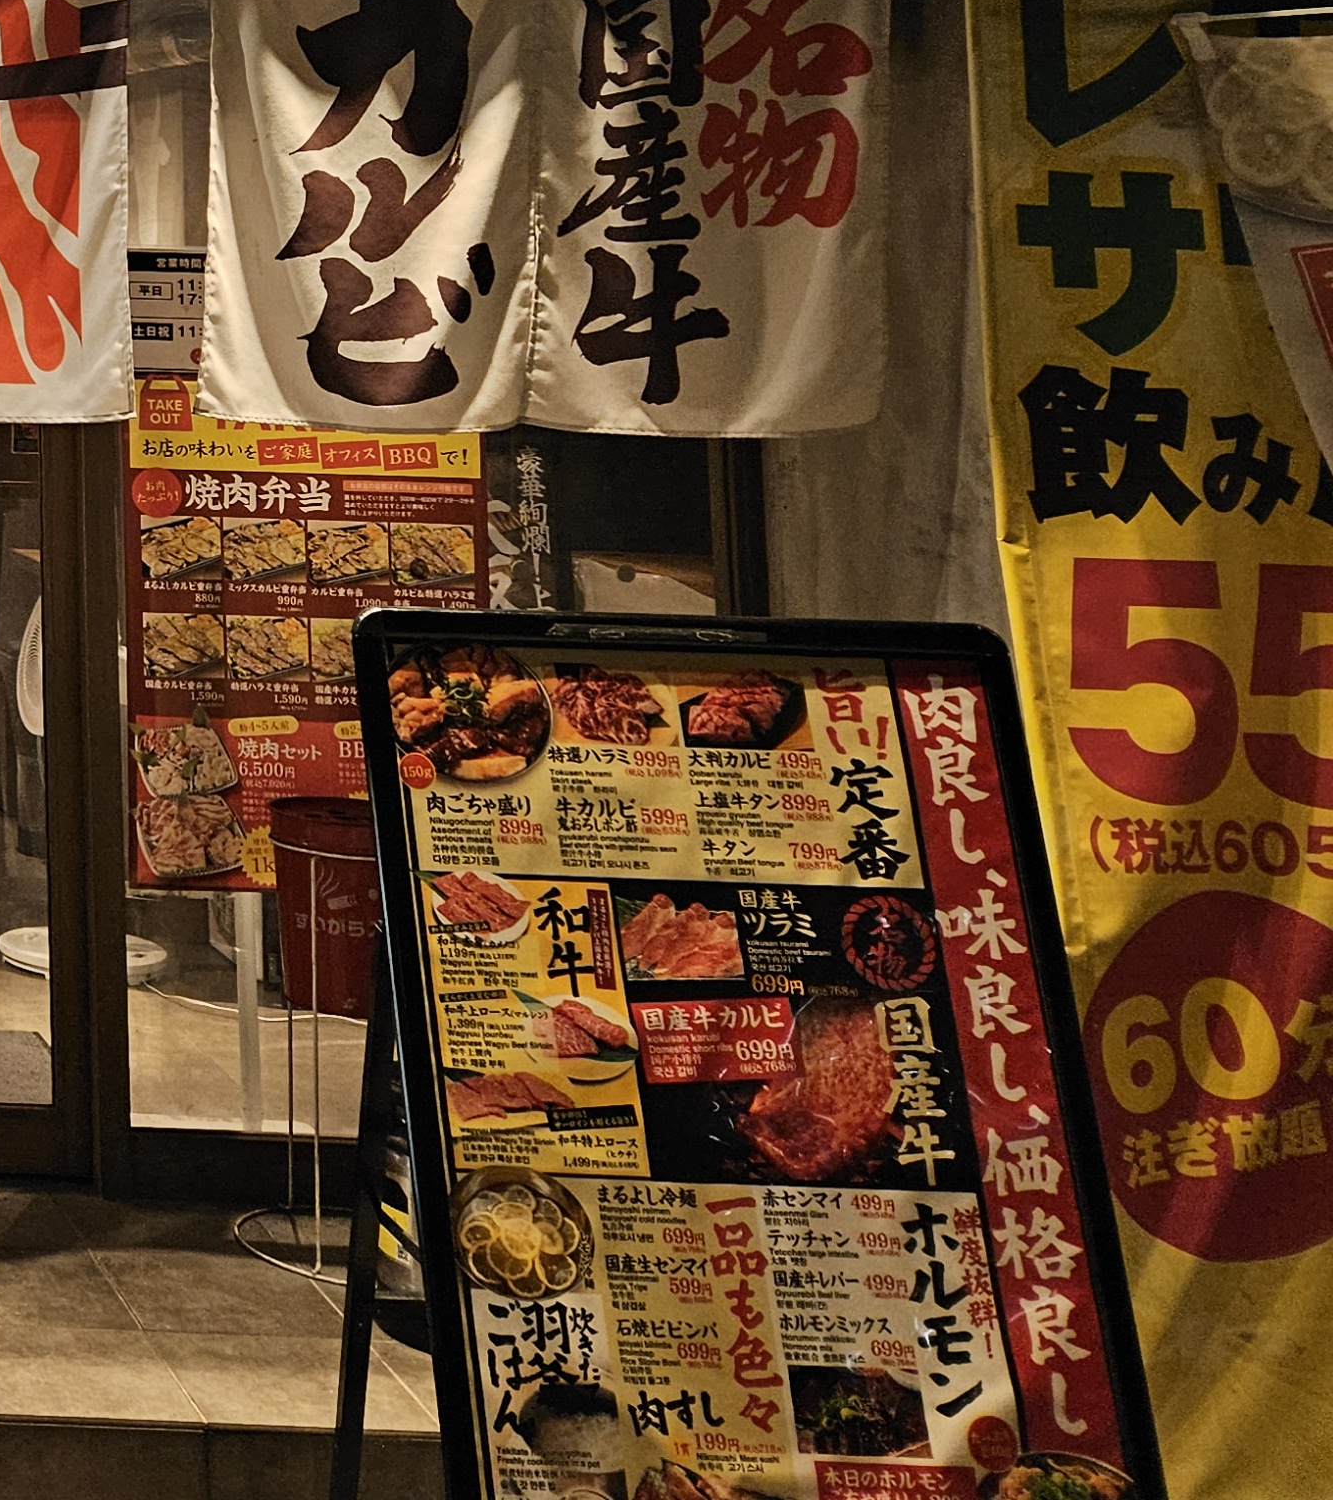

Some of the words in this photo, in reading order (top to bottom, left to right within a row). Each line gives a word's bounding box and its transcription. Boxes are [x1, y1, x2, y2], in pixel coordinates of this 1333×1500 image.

[139, 285, 162, 296] 平日
[134, 326, 170, 337] 土日祝
[147, 399, 183, 411] TAKE
[150, 413, 180, 424] OUT
[142, 438, 257, 459] お店の味わいを
[263, 441, 313, 459] ご家庭
[324, 447, 376, 462] オフィス
[389, 447, 431, 465] BBQ
[185, 474, 331, 514] 焼肉弁当
[195, 593, 220, 604] 880円
[277, 595, 304, 607] 990円
[238, 738, 321, 761] 焼肉セット
[548, 746, 630, 764] 特選ハラミ
[634, 751, 680, 769] 999円
[689, 750, 771, 769] 大判カルビ
[777, 753, 822, 771] 499円
[239, 762, 295, 779] 6,500円
[401, 764, 432, 781] 150g
[426, 791, 531, 816] 肉ごちゃ盛り
[556, 796, 636, 818] 牛カルビ
[695, 791, 780, 810] 上塩牛タン
[782, 794, 830, 813] 899円
[641, 808, 688, 827] 599円
[829, 758, 910, 881] 定番
[499, 819, 543, 836] 899円
[702, 838, 755, 857] 牛タン
[788, 843, 839, 861] 799円
[738, 888, 801, 910] 国産牛
[743, 912, 817, 938] ツラミ
[534, 887, 594, 997] 和牛
[752, 973, 804, 995] 699円
[641, 1003, 785, 1032] 国産牛カルビ
[736, 1039, 794, 1061] 699円
[874, 997, 955, 1185] 国産牛
[558, 1135, 638, 1148] 和牛特上ロース
[597, 1185, 697, 1208] まるよし冷麺
[763, 1189, 842, 1209] 赤センマイ
[851, 1195, 895, 1213] 499円
[663, 1228, 705, 1246] 699円
[768, 1229, 850, 1248] テッチャン
[857, 1232, 901, 1251] 499円
[670, 1278, 712, 1297] 599円
[773, 1270, 859, 1288] 国産牛レバー
[864, 1274, 908, 1293] 499円
[705, 1196, 783, 1434] 一品も色々
[901, 1203, 983, 1418] ホルモン
[617, 1319, 719, 1340] 石焼ビビンバ
[779, 1313, 892, 1334] ホルモンミックス
[677, 1342, 721, 1362] 699円
[871, 1340, 916, 1358] 699円
[627, 1390, 725, 1436] 肉すし
